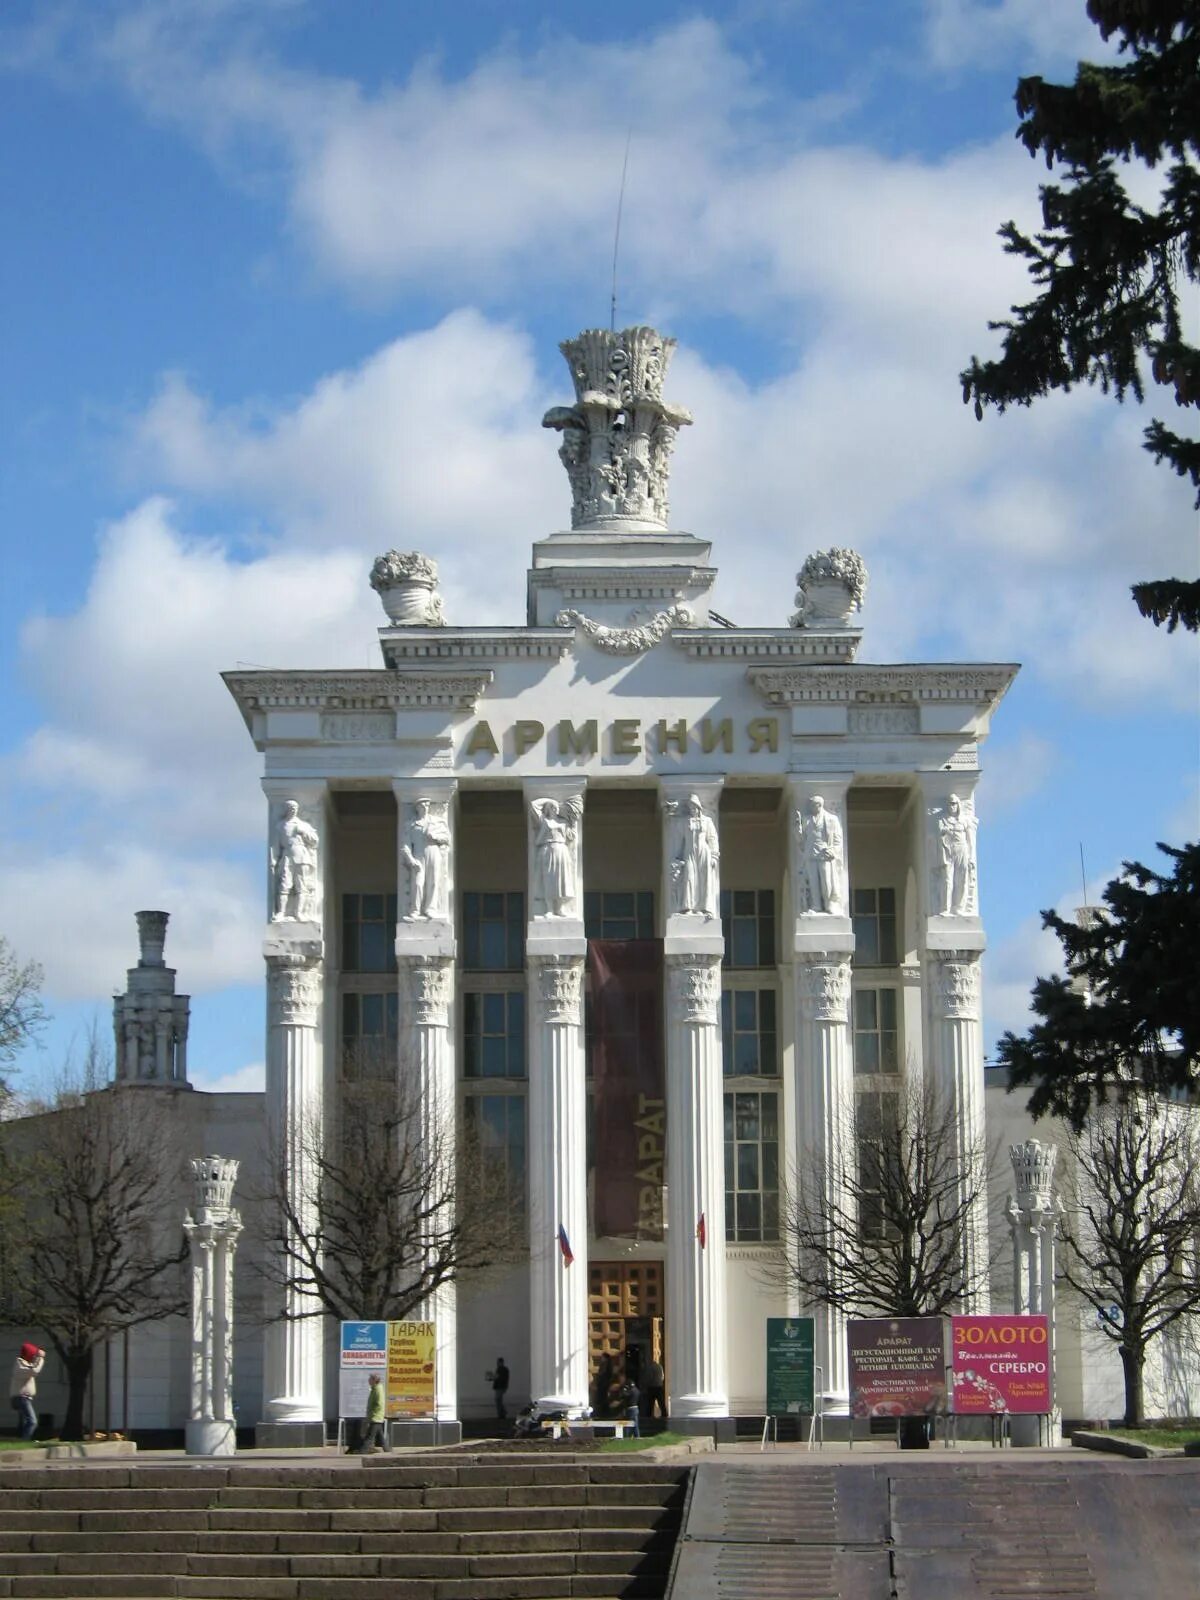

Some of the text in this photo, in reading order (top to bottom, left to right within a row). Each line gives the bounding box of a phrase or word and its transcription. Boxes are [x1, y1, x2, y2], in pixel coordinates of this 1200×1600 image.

[466, 718, 780, 755] АРМЕНИЯ
[635, 1092, 665, 1239] АРАРАТ
[389, 1322, 434, 1337] ТАБАК
[954, 1326, 1047, 1344] ЗОЛОТО
[876, 1338, 912, 1346] АРАРАТ
[989, 1362, 1046, 1374] СЕРЕБРО
